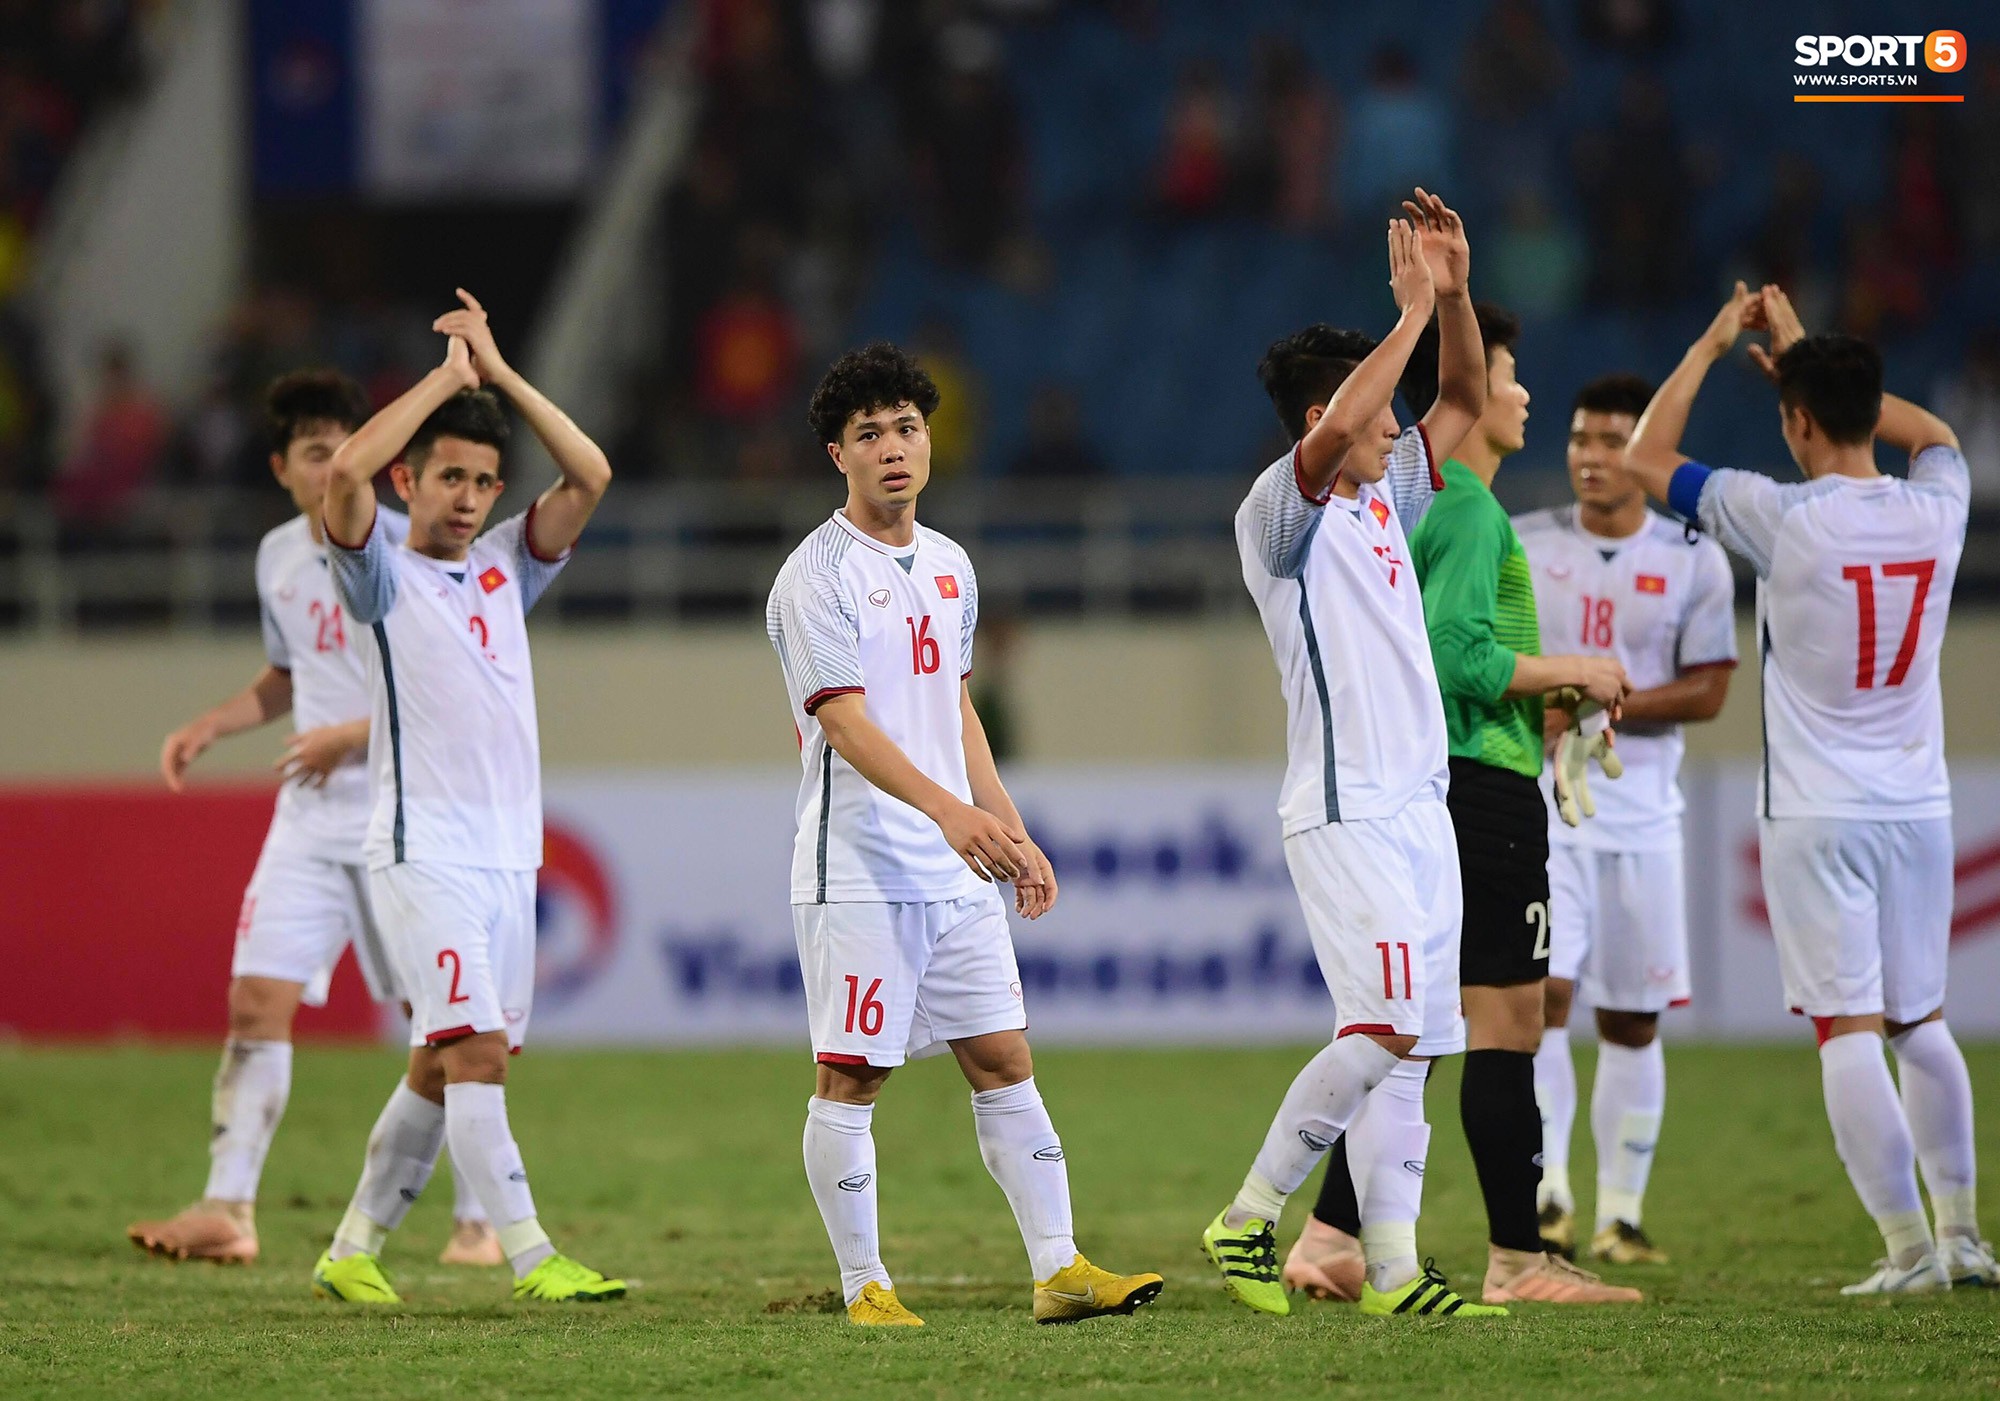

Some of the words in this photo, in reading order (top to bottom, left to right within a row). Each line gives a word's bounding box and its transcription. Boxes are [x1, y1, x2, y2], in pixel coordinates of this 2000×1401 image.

[906, 615, 940, 675] 16
[1582, 595, 1614, 649] 18
[1843, 559, 1936, 689] 17
[437, 949, 470, 1004] 2
[1375, 942, 1411, 1000] 11
[844, 974, 884, 1036] 16
